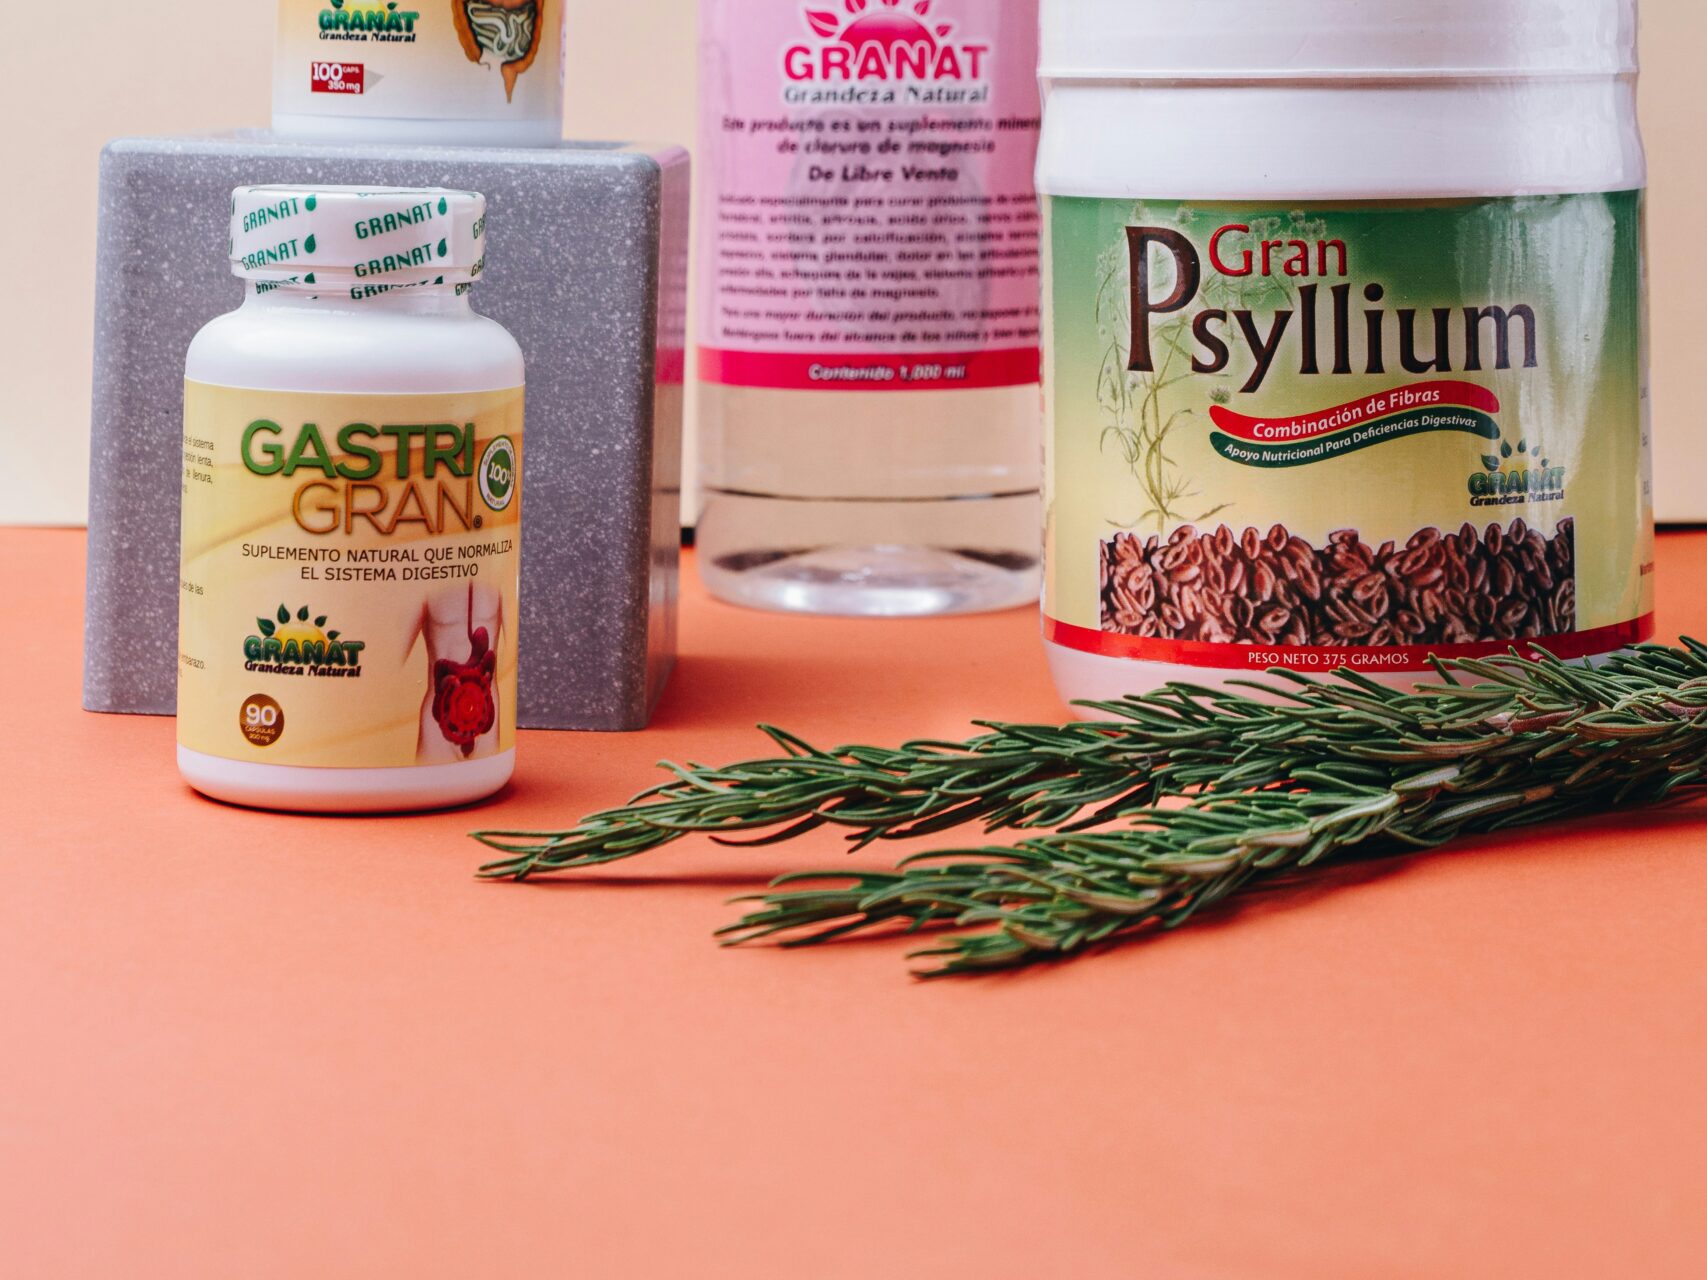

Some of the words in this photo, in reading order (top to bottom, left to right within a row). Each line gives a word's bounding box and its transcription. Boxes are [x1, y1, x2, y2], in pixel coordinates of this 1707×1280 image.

[318, 8, 419, 34] GRANAT
[319, 31, 367, 42] Grandeza
[371, 32, 416, 43] Natural
[312, 63, 343, 81] 100
[783, 43, 989, 81] GRANAT
[783, 86, 896, 104] Grandeza
[904, 86, 989, 104] Natural
[751, 116, 825, 136] producto
[831, 122, 850, 132] es
[857, 121, 881, 132] un
[888, 116, 993, 137] suplemento
[777, 138, 797, 154] de
[805, 138, 871, 155] cloruro
[877, 137, 899, 154] de
[908, 141, 995, 157] magnesio
[809, 165, 834, 182] De
[842, 165, 893, 182] Libre
[901, 166, 959, 182] Venta
[243, 197, 298, 233] GRANAT
[354, 201, 432, 239] GRANAT
[241, 238, 298, 271] GRANAT
[354, 243, 432, 278] GRANAT
[1208, 224, 1348, 277] Gran
[1124, 225, 1539, 393] Psyllium
[808, 363, 894, 381] Contenido
[899, 363, 943, 382] 1,000
[1252, 407, 1362, 439] Combinación
[1365, 398, 1386, 416] de
[1389, 388, 1441, 408] Fibras
[240, 418, 475, 481] GASTRI
[1224, 443, 1260, 461] Apoyo
[1262, 443, 1324, 462] Nutricional
[1326, 437, 1352, 453] Para
[1353, 418, 1420, 443] Deficiencias
[1421, 414, 1478, 430] Digestivas
[1467, 466, 1566, 496] GRANAT
[1469, 493, 1525, 507] Grandeza
[1527, 489, 1564, 503] Natural
[242, 543, 341, 563] SUPLEMENTO
[347, 548, 419, 563] NATURAL
[424, 547, 452, 563] QUE
[457, 539, 513, 560] NORMALIZA
[301, 566, 319, 580] EL
[324, 568, 396, 581] SISTEMA
[402, 563, 479, 581] DIGESTIVO
[243, 634, 365, 667] GRANAT
[1248, 651, 1279, 665] PESO
[1283, 653, 1319, 665] NETO
[1323, 653, 1347, 666] 375
[1351, 652, 1410, 666] GRAMOS
[244, 660, 304, 677] Grandeza
[307, 663, 361, 678] Natural
[246, 703, 277, 727] 90
